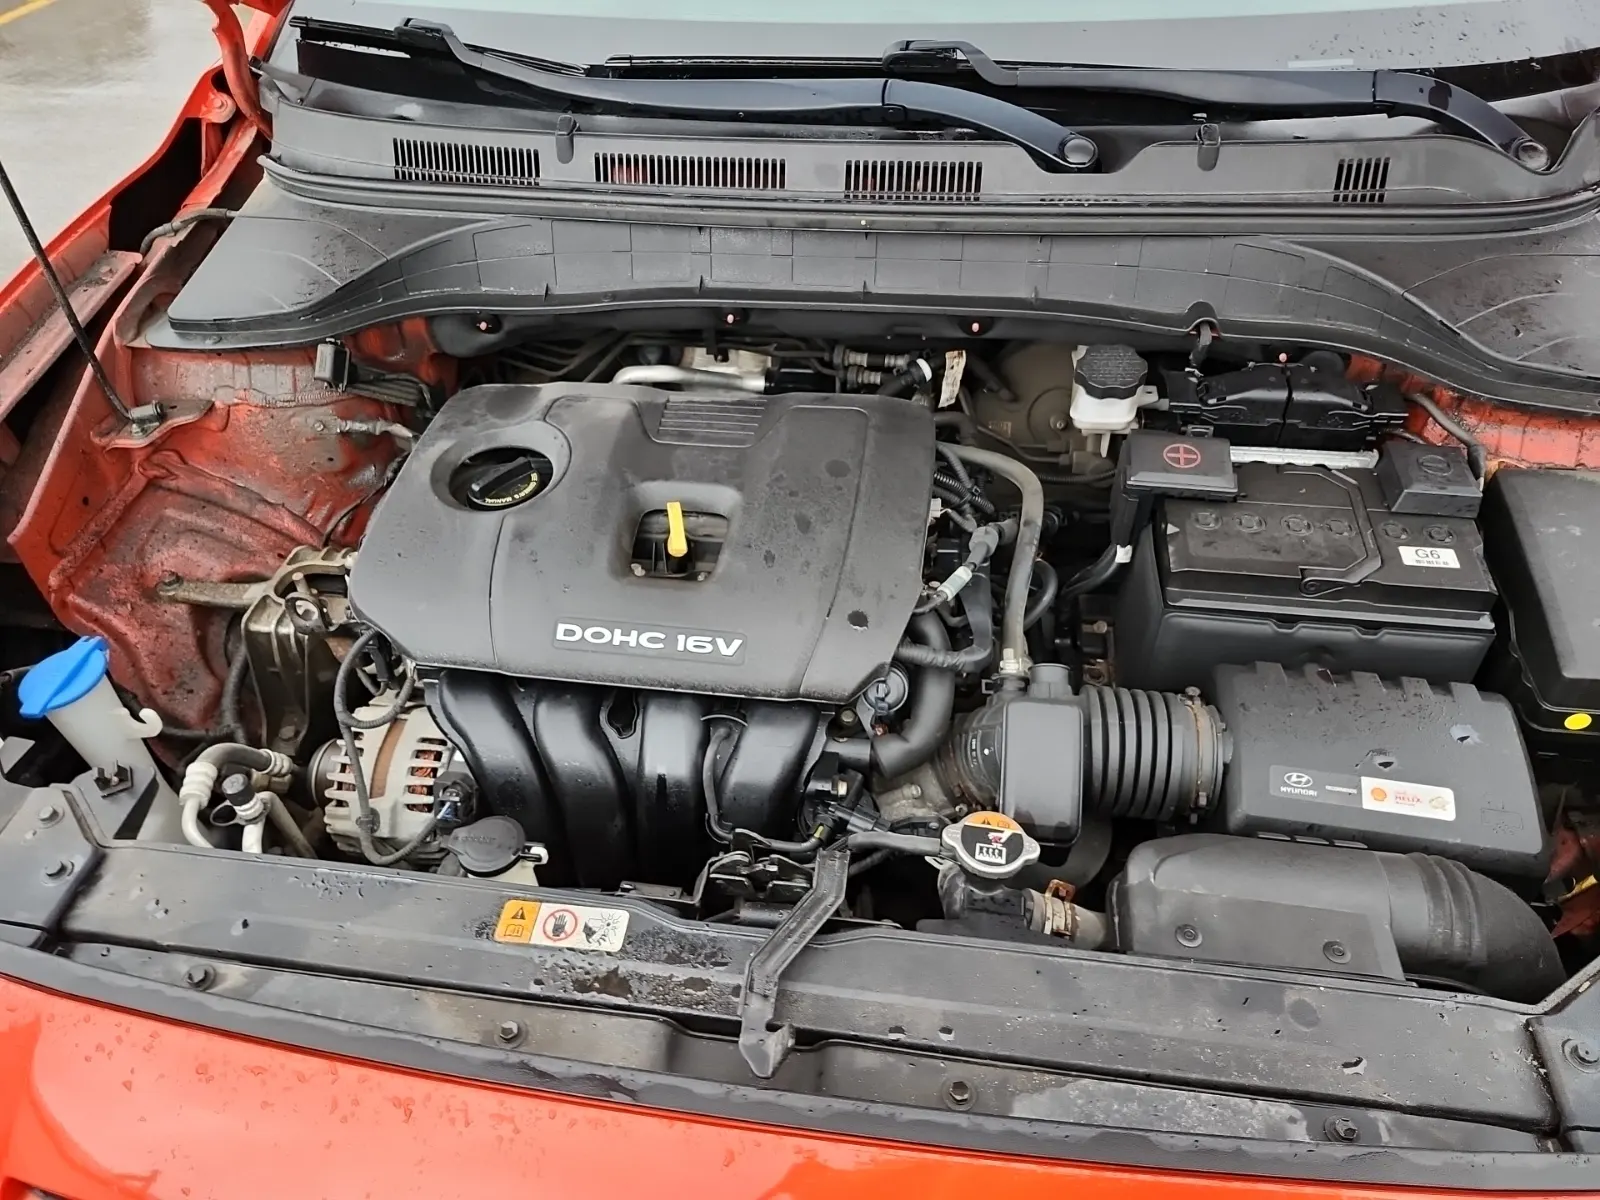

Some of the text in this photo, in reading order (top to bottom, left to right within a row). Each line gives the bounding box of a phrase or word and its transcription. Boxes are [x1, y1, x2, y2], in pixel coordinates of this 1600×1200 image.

[1415, 549, 1440, 559] G6
[555, 622, 743, 657] DOHC 16V
[1280, 786, 1317, 797] HYUNDAI
